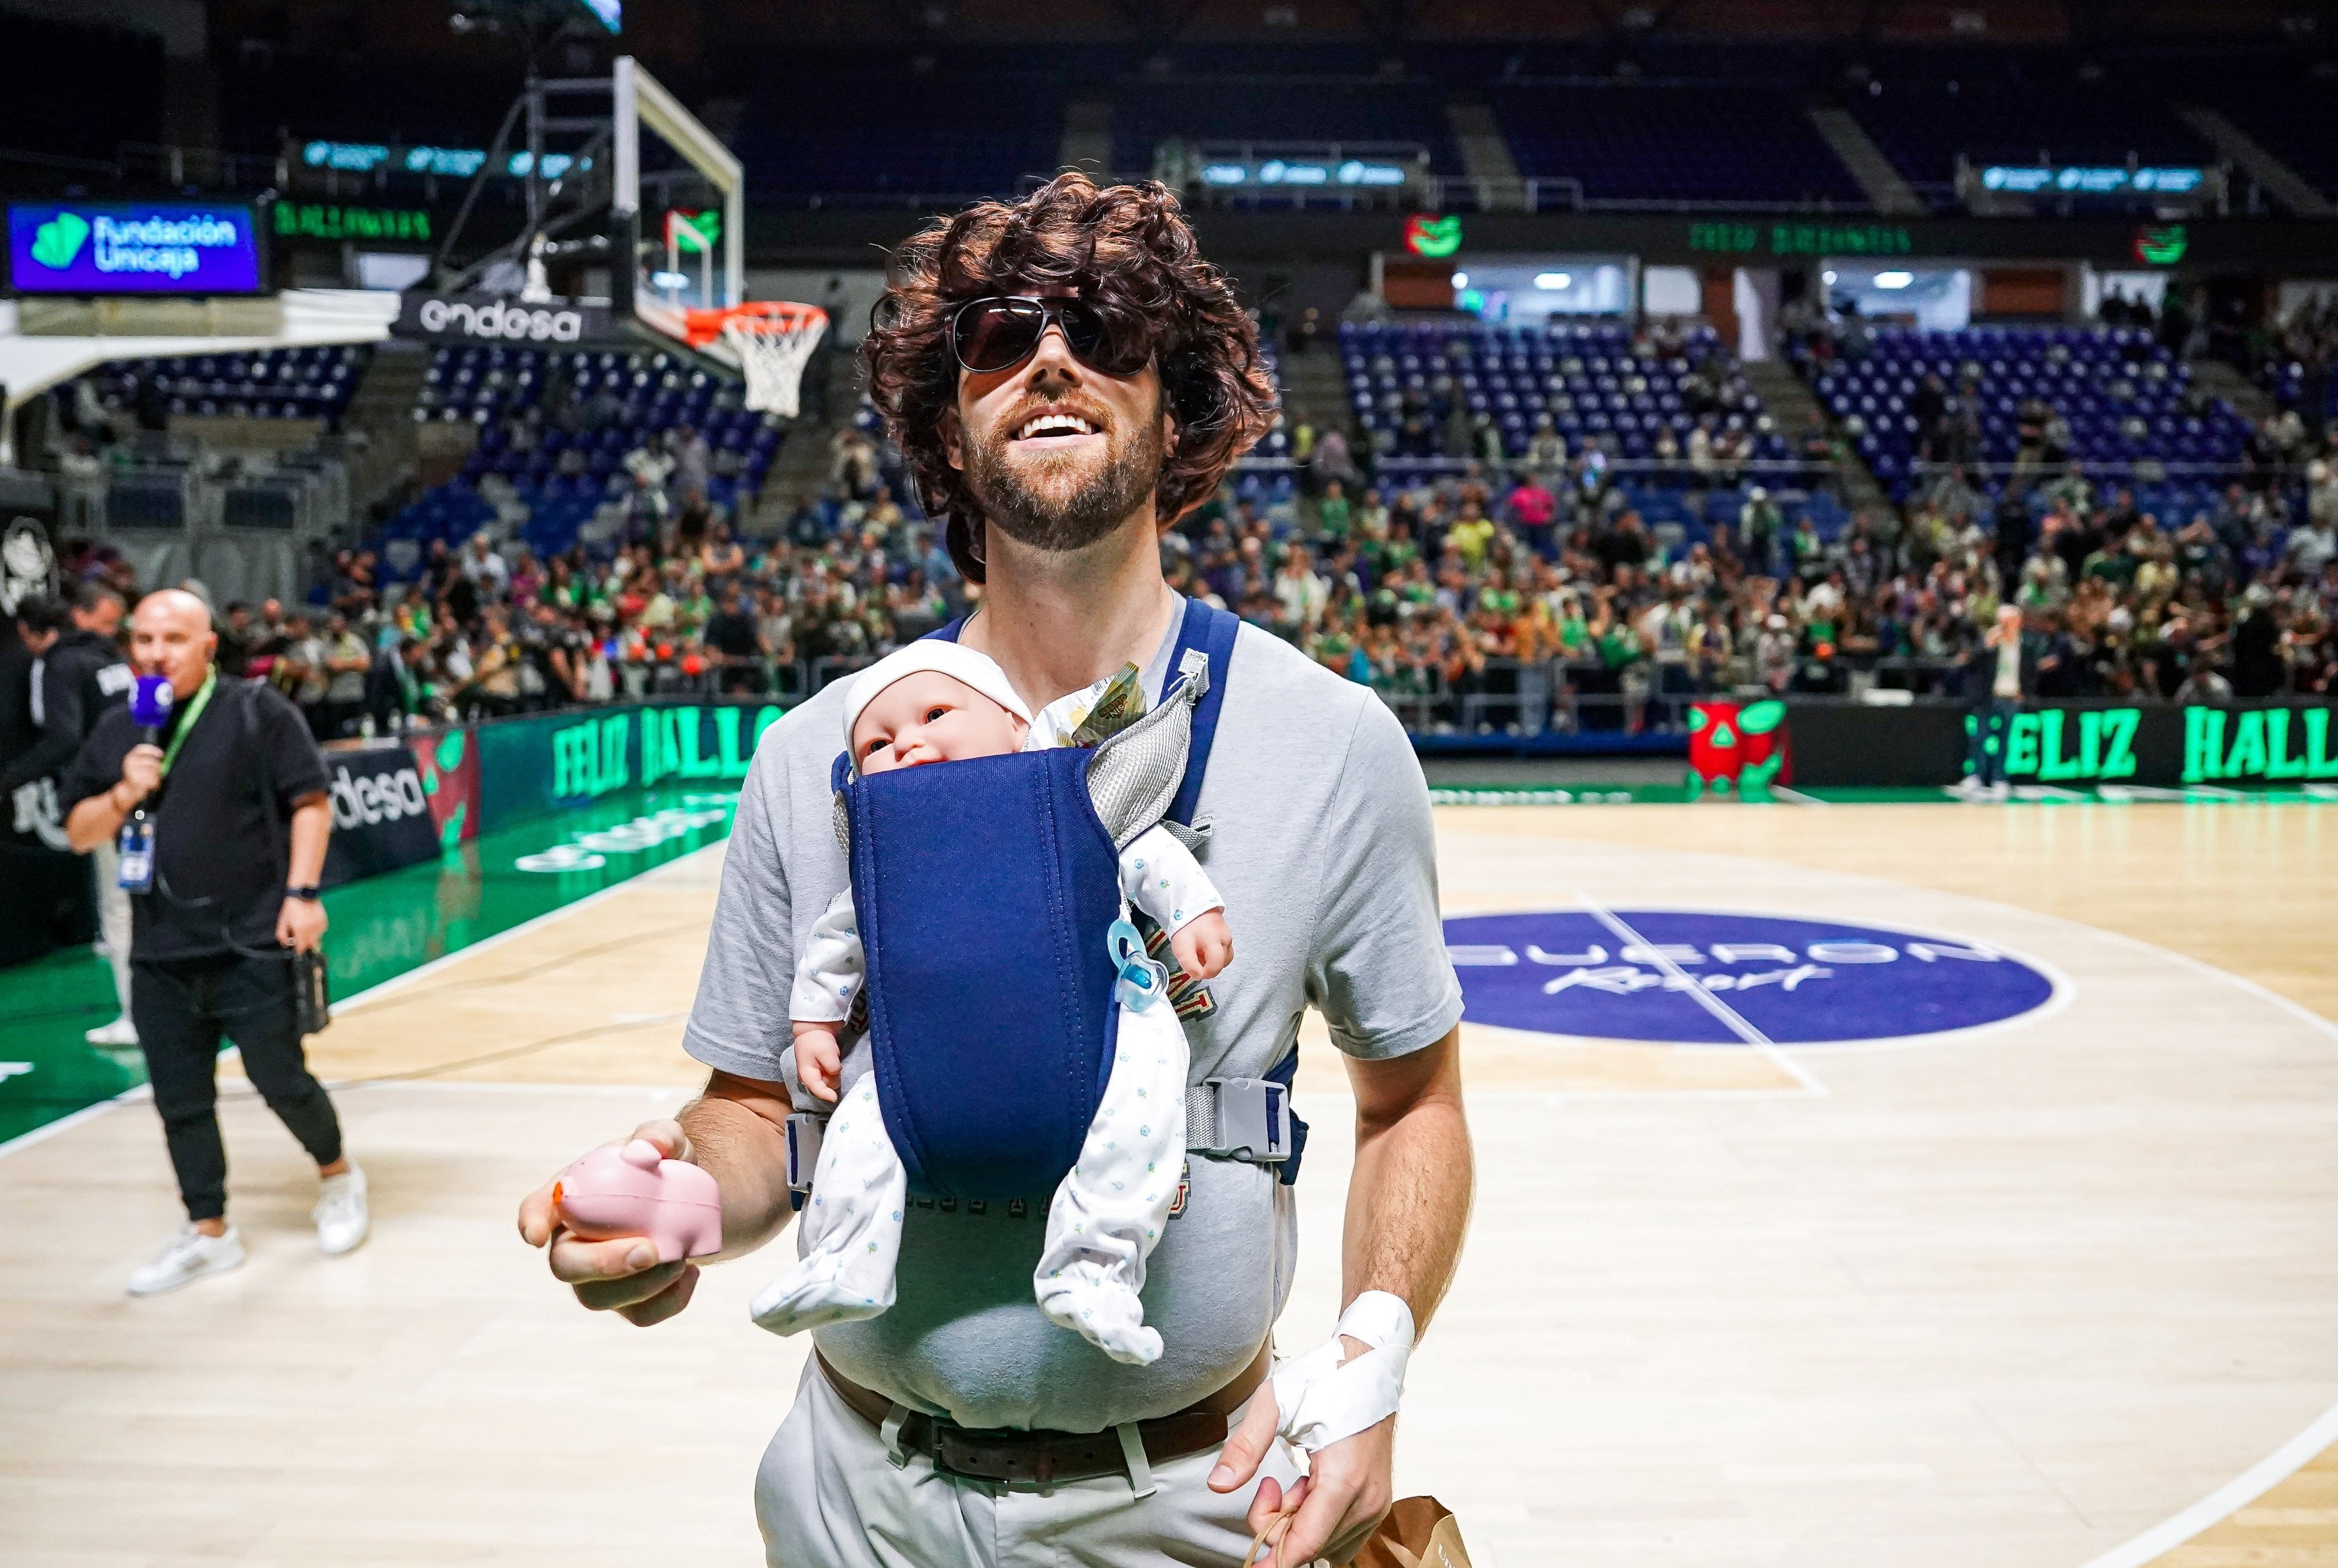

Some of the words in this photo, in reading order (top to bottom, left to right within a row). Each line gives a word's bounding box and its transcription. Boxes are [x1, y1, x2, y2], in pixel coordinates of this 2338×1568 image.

[92, 213, 236, 247] Fundación
[94, 239, 200, 280] Unicaja
[2179, 705, 2338, 783] HALL
[328, 765, 427, 829] desa
